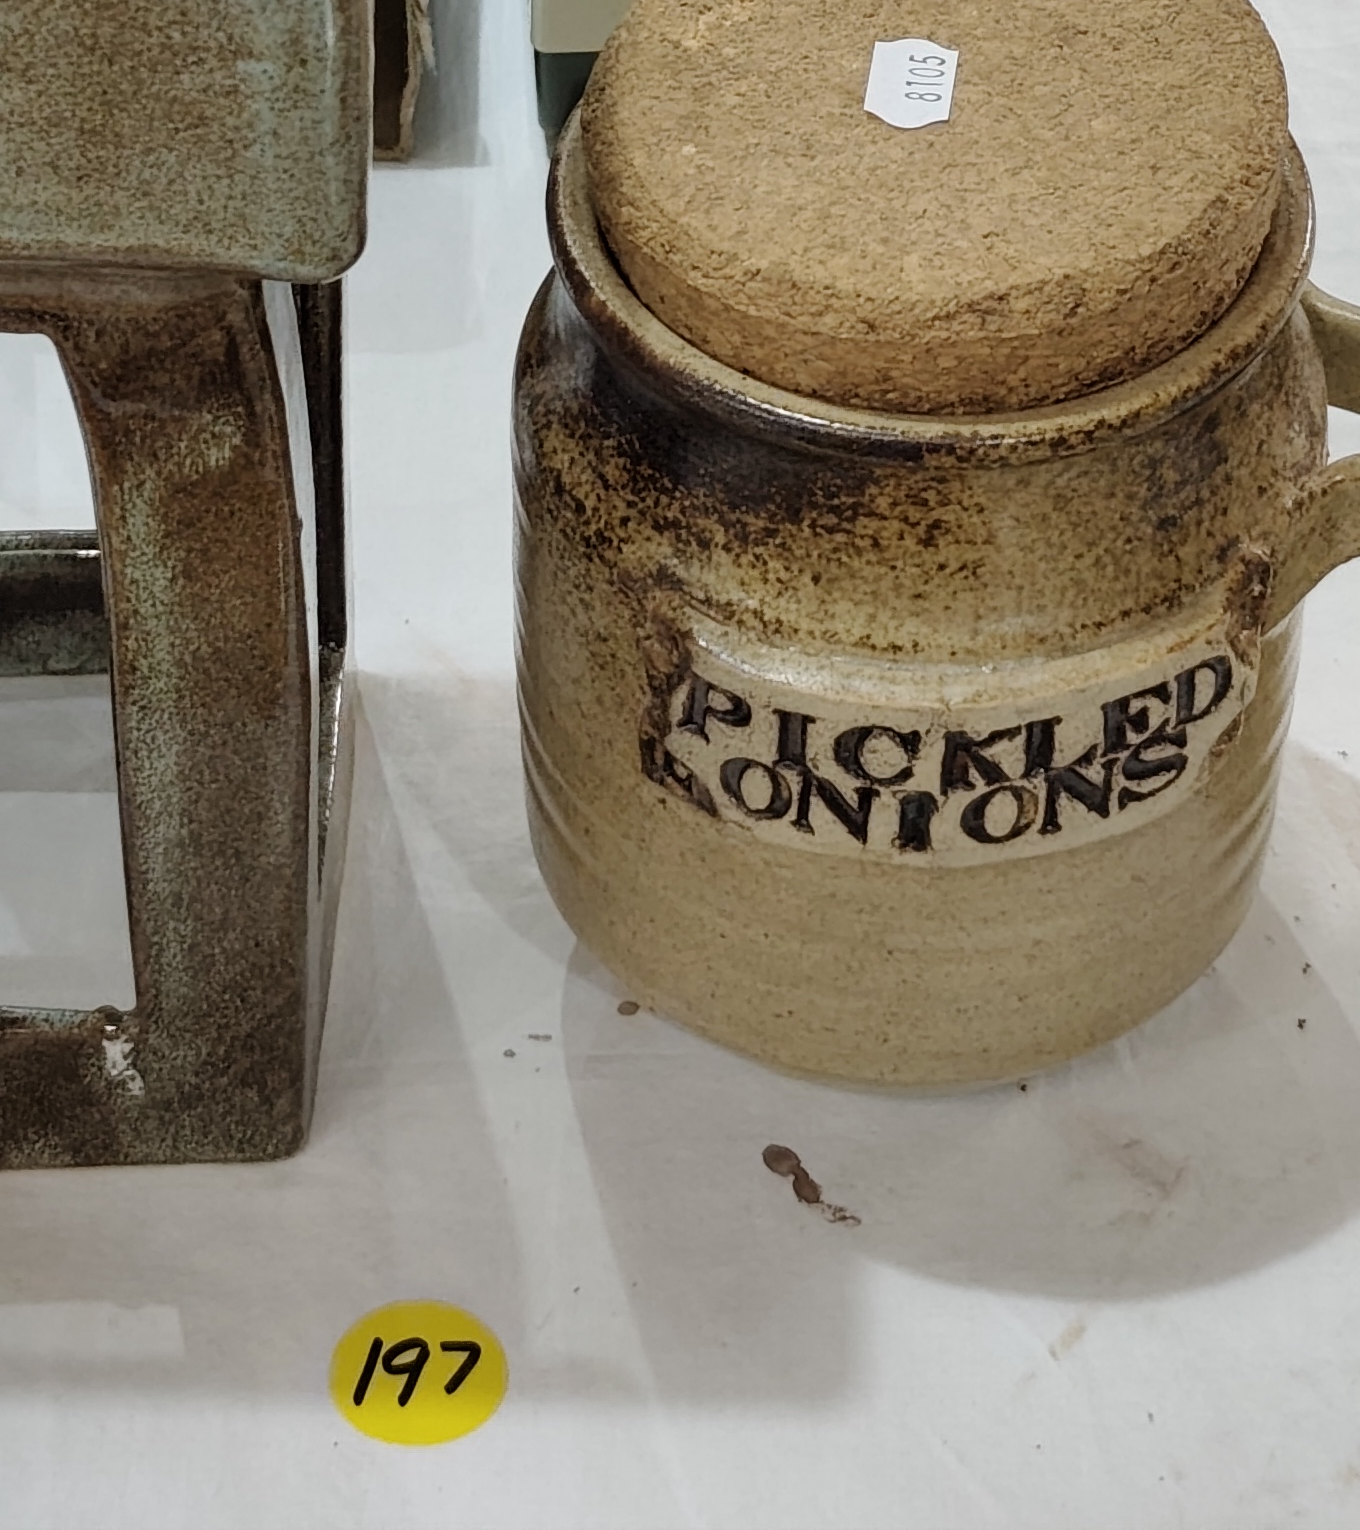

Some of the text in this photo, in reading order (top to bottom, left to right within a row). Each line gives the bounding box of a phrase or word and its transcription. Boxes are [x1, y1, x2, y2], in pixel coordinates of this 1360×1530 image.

[905, 55, 946, 102] 8105
[677, 655, 1232, 794] PICKLED
[720, 718, 1189, 851] ONIONS
[353, 1337, 481, 1407] 197
